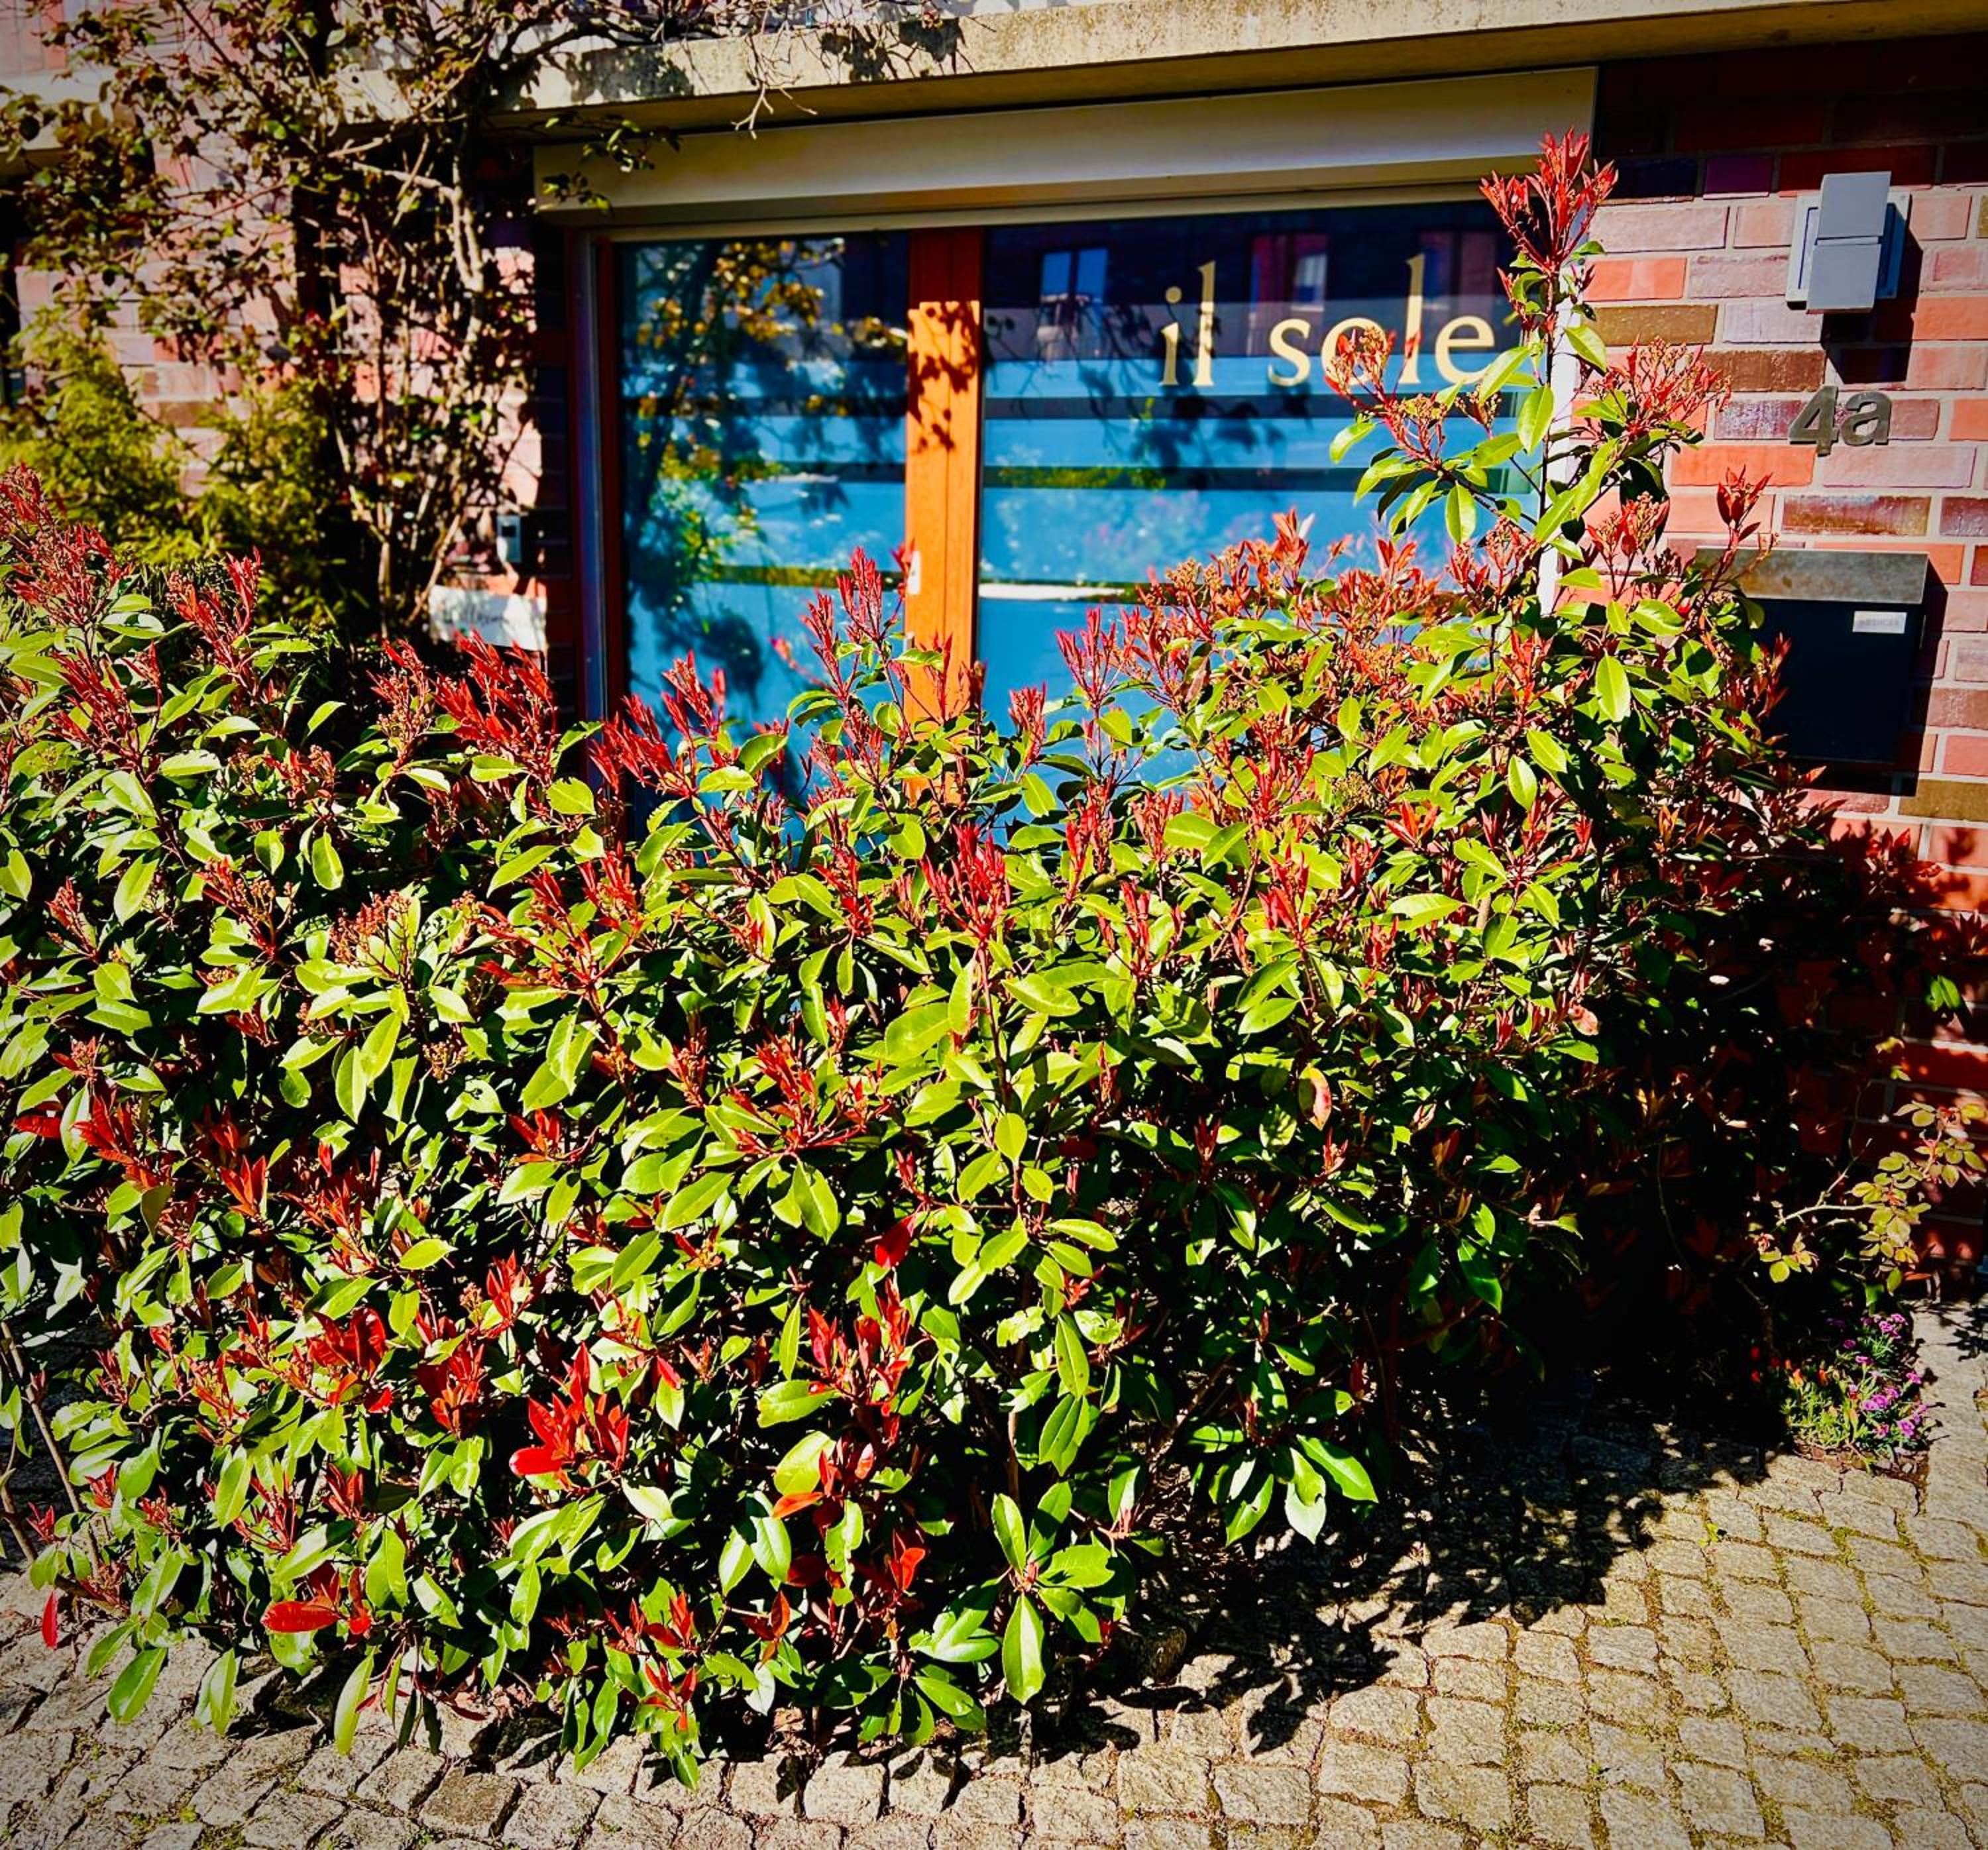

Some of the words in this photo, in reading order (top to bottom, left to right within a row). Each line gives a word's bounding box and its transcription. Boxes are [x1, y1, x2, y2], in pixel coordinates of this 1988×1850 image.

[1158, 260, 1216, 386] il
[1267, 254, 1495, 387] sole
[1789, 386, 1891, 457] 4a
